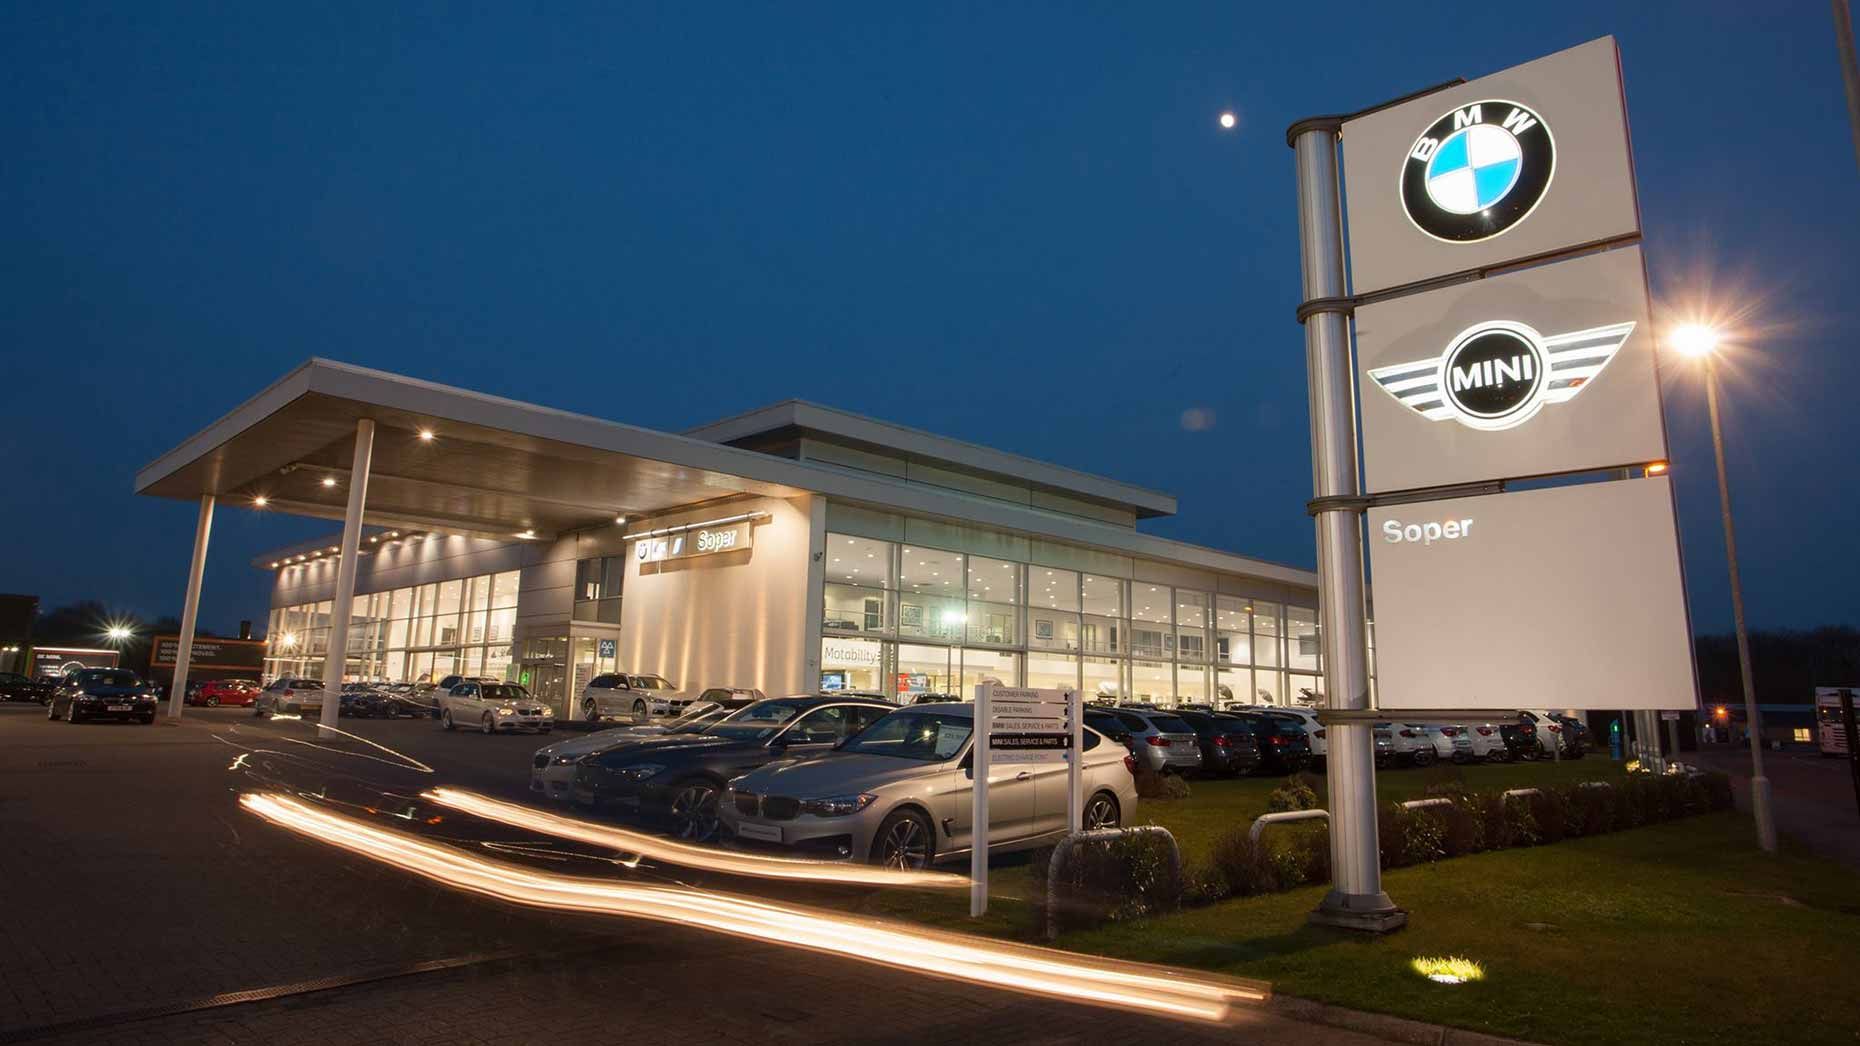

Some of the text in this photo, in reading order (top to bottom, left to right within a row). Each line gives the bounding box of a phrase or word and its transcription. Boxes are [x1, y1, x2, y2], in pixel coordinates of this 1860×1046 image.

[1411, 104, 1536, 162] BMW
[1451, 354, 1533, 393] MINI
[697, 529, 737, 552] Soper
[1383, 518, 1473, 546] Soper
[824, 647, 877, 665] Motability
[992, 689, 1039, 698] CUSTOMER PARKING
[1012, 706, 1032, 714] PARKING
[1022, 721, 1040, 729] SERVICE
